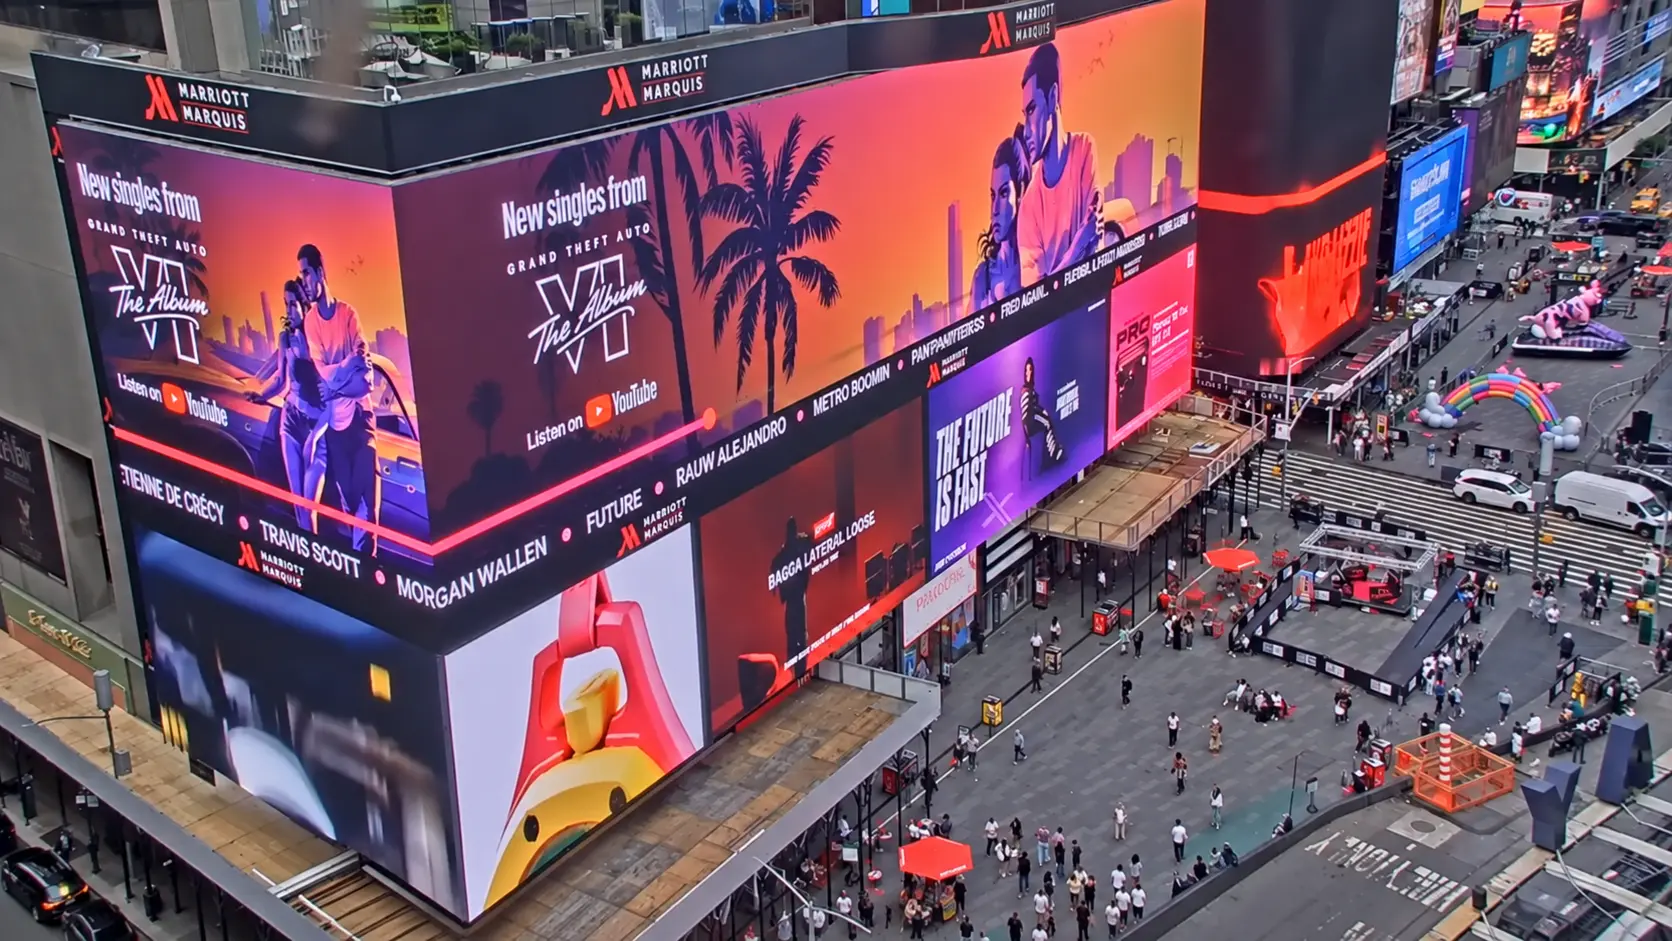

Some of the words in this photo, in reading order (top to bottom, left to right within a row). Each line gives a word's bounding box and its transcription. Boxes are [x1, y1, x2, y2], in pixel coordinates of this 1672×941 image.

[1015, 3, 1056, 22] MARRIOTT
[1015, 22, 1050, 42] MARQUIS
[641, 54, 708, 80] MARRIOTT
[642, 75, 704, 102] MARQUIS
[178, 82, 249, 108] MARRIOTT
[182, 105, 246, 130] MARQUIS
[77, 162, 111, 200] New
[112, 171, 161, 215] singles
[161, 181, 202, 223] from
[501, 200, 543, 239] New
[546, 182, 606, 227] singles
[607, 175, 647, 210] from
[87, 218, 126, 238] GRAND
[132, 228, 168, 248] THEFT
[175, 239, 207, 257] AUTO
[507, 251, 557, 275] GRAND
[565, 234, 608, 258] THEFT
[616, 222, 650, 242] AUTO
[109, 285, 144, 318] The
[147, 284, 209, 316] Album
[110, 245, 199, 365] VI
[527, 314, 571, 364] The
[574, 279, 647, 334] Album
[535, 253, 629, 374] VI
[1001, 297, 1020, 320] FRED
[117, 372, 148, 399] Listen
[148, 387, 162, 404] on
[185, 390, 228, 427] YouTube
[526, 424, 566, 451] Listen
[567, 415, 583, 433] on
[612, 379, 657, 415] YouTube
[813, 384, 850, 417] METRO
[851, 362, 890, 398] BOOMIN
[676, 451, 715, 488] RAUW
[716, 416, 787, 467] ALEJANDRO
[935, 418, 962, 480] THE
[963, 386, 1013, 462] FUTURE
[165, 485, 183, 509] DE
[184, 490, 225, 526] CRÉCY
[586, 488, 642, 534] FUTURE
[935, 469, 952, 532] IS
[953, 450, 987, 520] FAST
[259, 519, 310, 558] TRAVIS
[312, 541, 360, 579] SCOTT
[644, 512, 683, 541] MARQUIS
[768, 561, 802, 591] BAGGA
[803, 533, 845, 568] LATERAL
[846, 510, 875, 540] LOOSE
[397, 571, 475, 610] MORGAN
[477, 535, 548, 588] WALLEN
